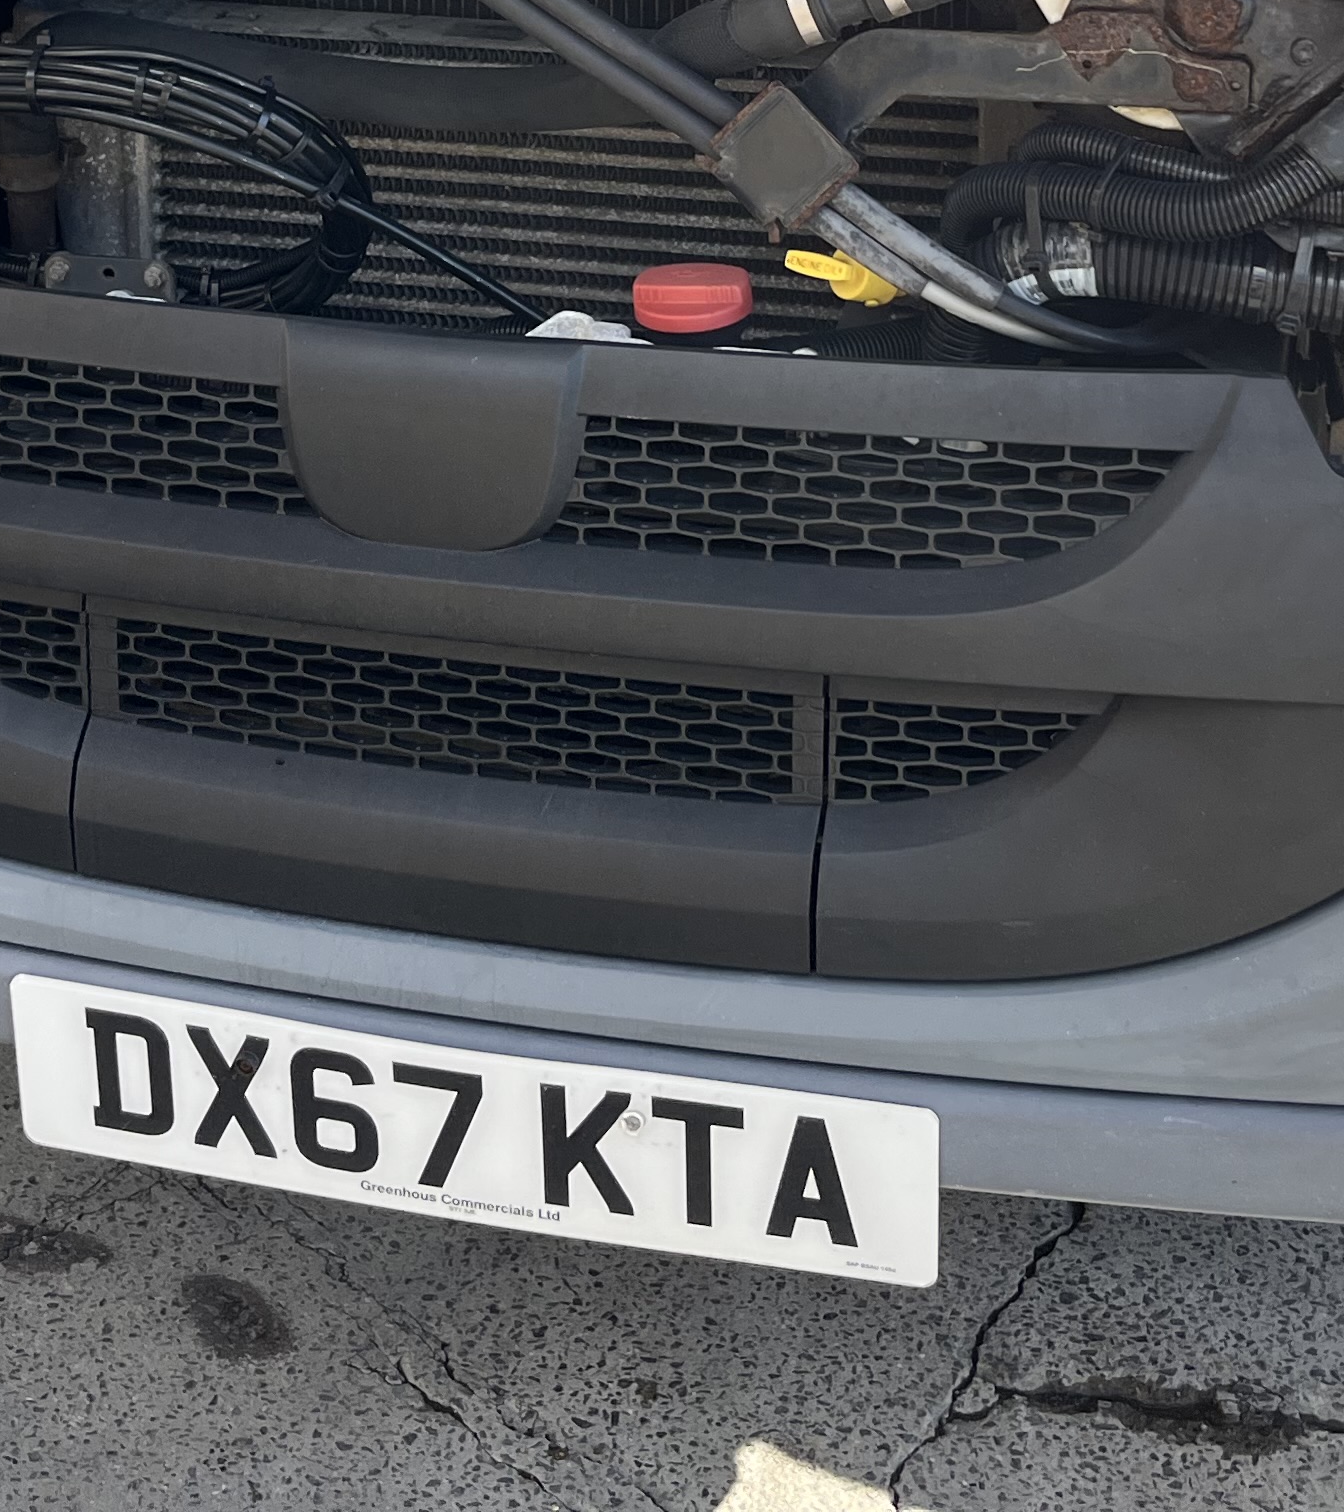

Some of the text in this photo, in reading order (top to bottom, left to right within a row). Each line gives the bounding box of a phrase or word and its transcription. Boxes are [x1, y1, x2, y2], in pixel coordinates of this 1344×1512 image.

[85, 1007, 860, 1249] DX67 KTA
[360, 1179, 561, 1221] Greenhous Commercials Ltd
